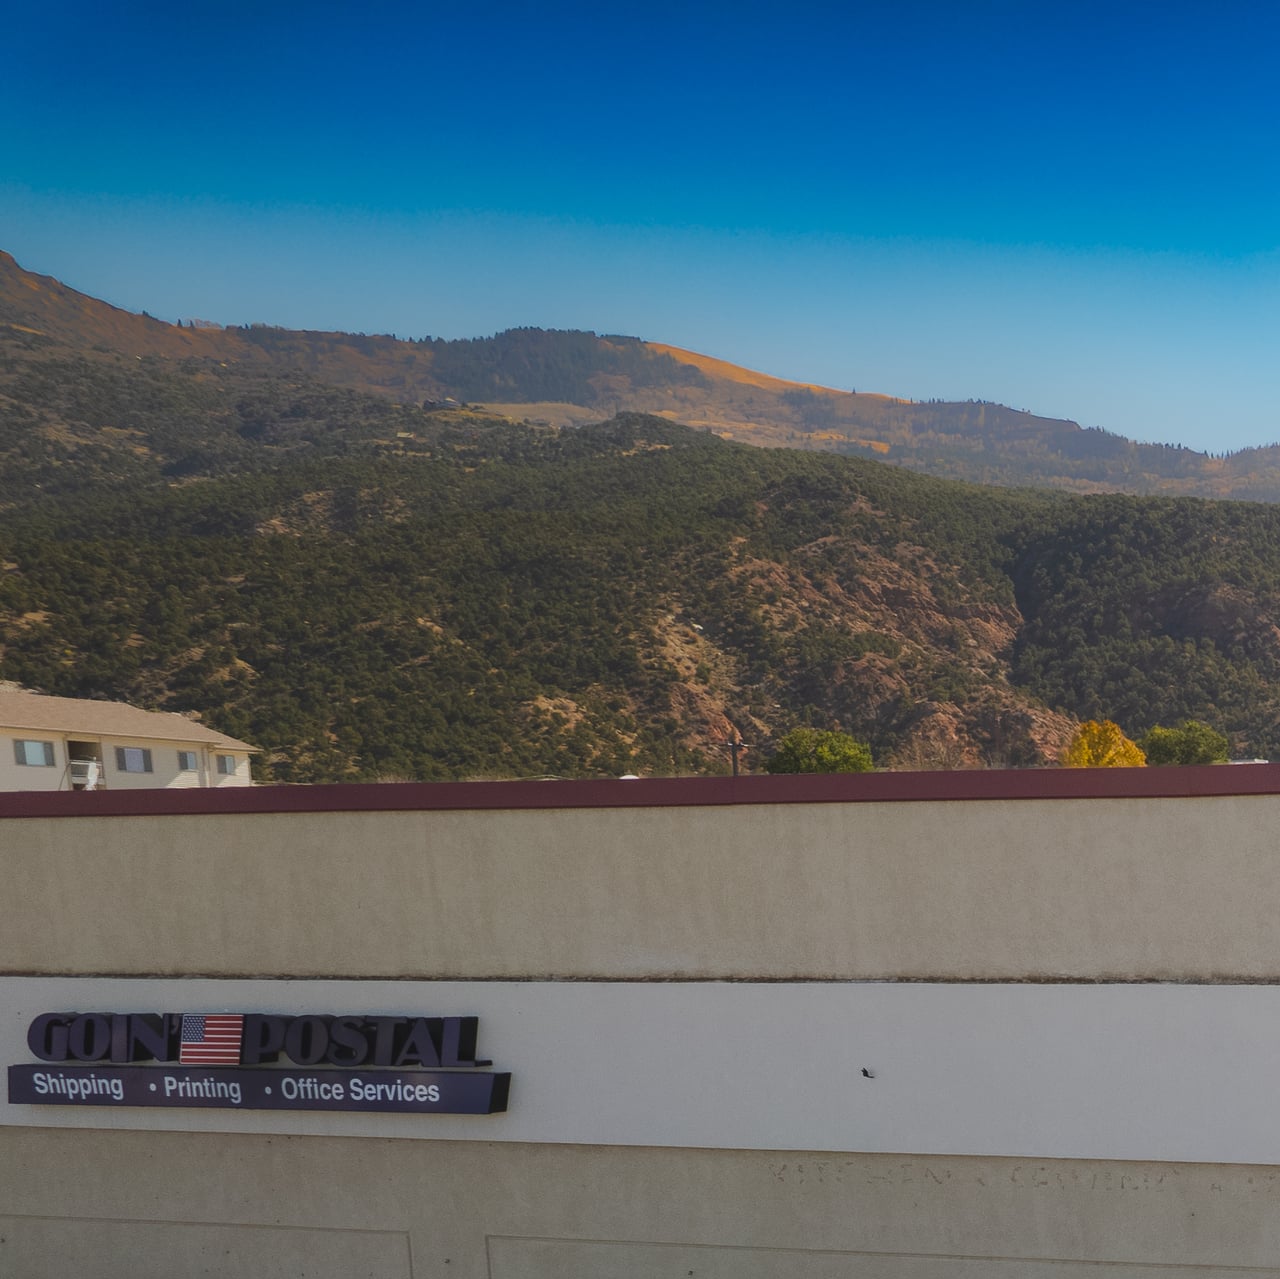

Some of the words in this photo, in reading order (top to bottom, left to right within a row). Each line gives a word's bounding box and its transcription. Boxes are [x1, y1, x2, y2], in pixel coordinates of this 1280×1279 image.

[243, 1014, 493, 1068] POSTAL
[33, 1073, 124, 1100] Shipping
[163, 1076, 242, 1104] Printing
[281, 1077, 344, 1101] Office
[350, 1079, 441, 1102] Services
